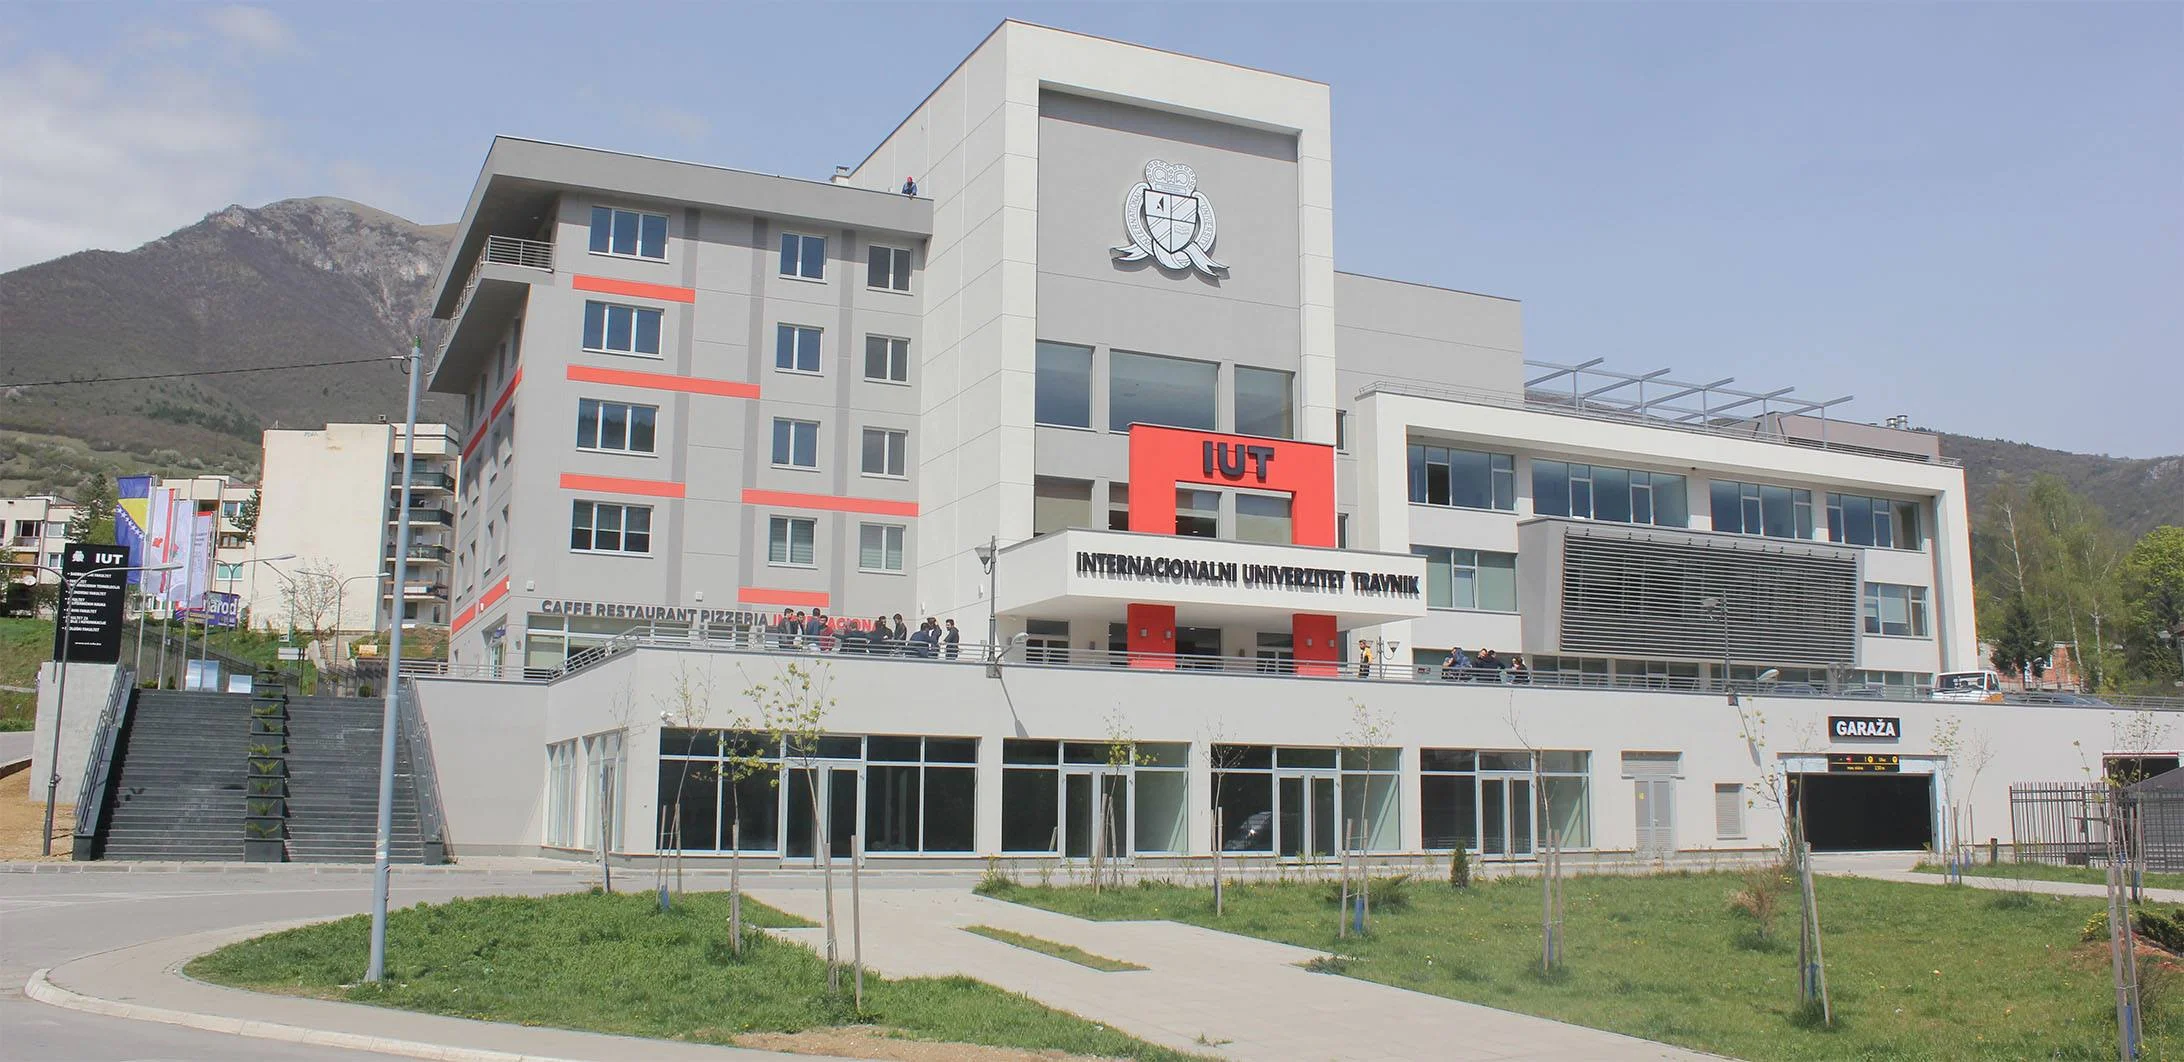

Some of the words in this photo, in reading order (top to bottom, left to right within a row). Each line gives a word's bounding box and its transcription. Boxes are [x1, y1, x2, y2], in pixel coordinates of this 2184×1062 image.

[1203, 441, 1274, 480] IUT
[95, 553, 123, 564] IUT
[1076, 551, 1237, 583] INTERNACIONALNI
[1242, 564, 1345, 589] UNIVERZITET
[1351, 572, 1420, 594] TRAVNIK
[542, 600, 592, 616] CAFFE
[596, 604, 697, 622] RESTAURANT
[701, 609, 768, 627] PIZZERIA
[1836, 718, 1896, 736] GARAŽA
